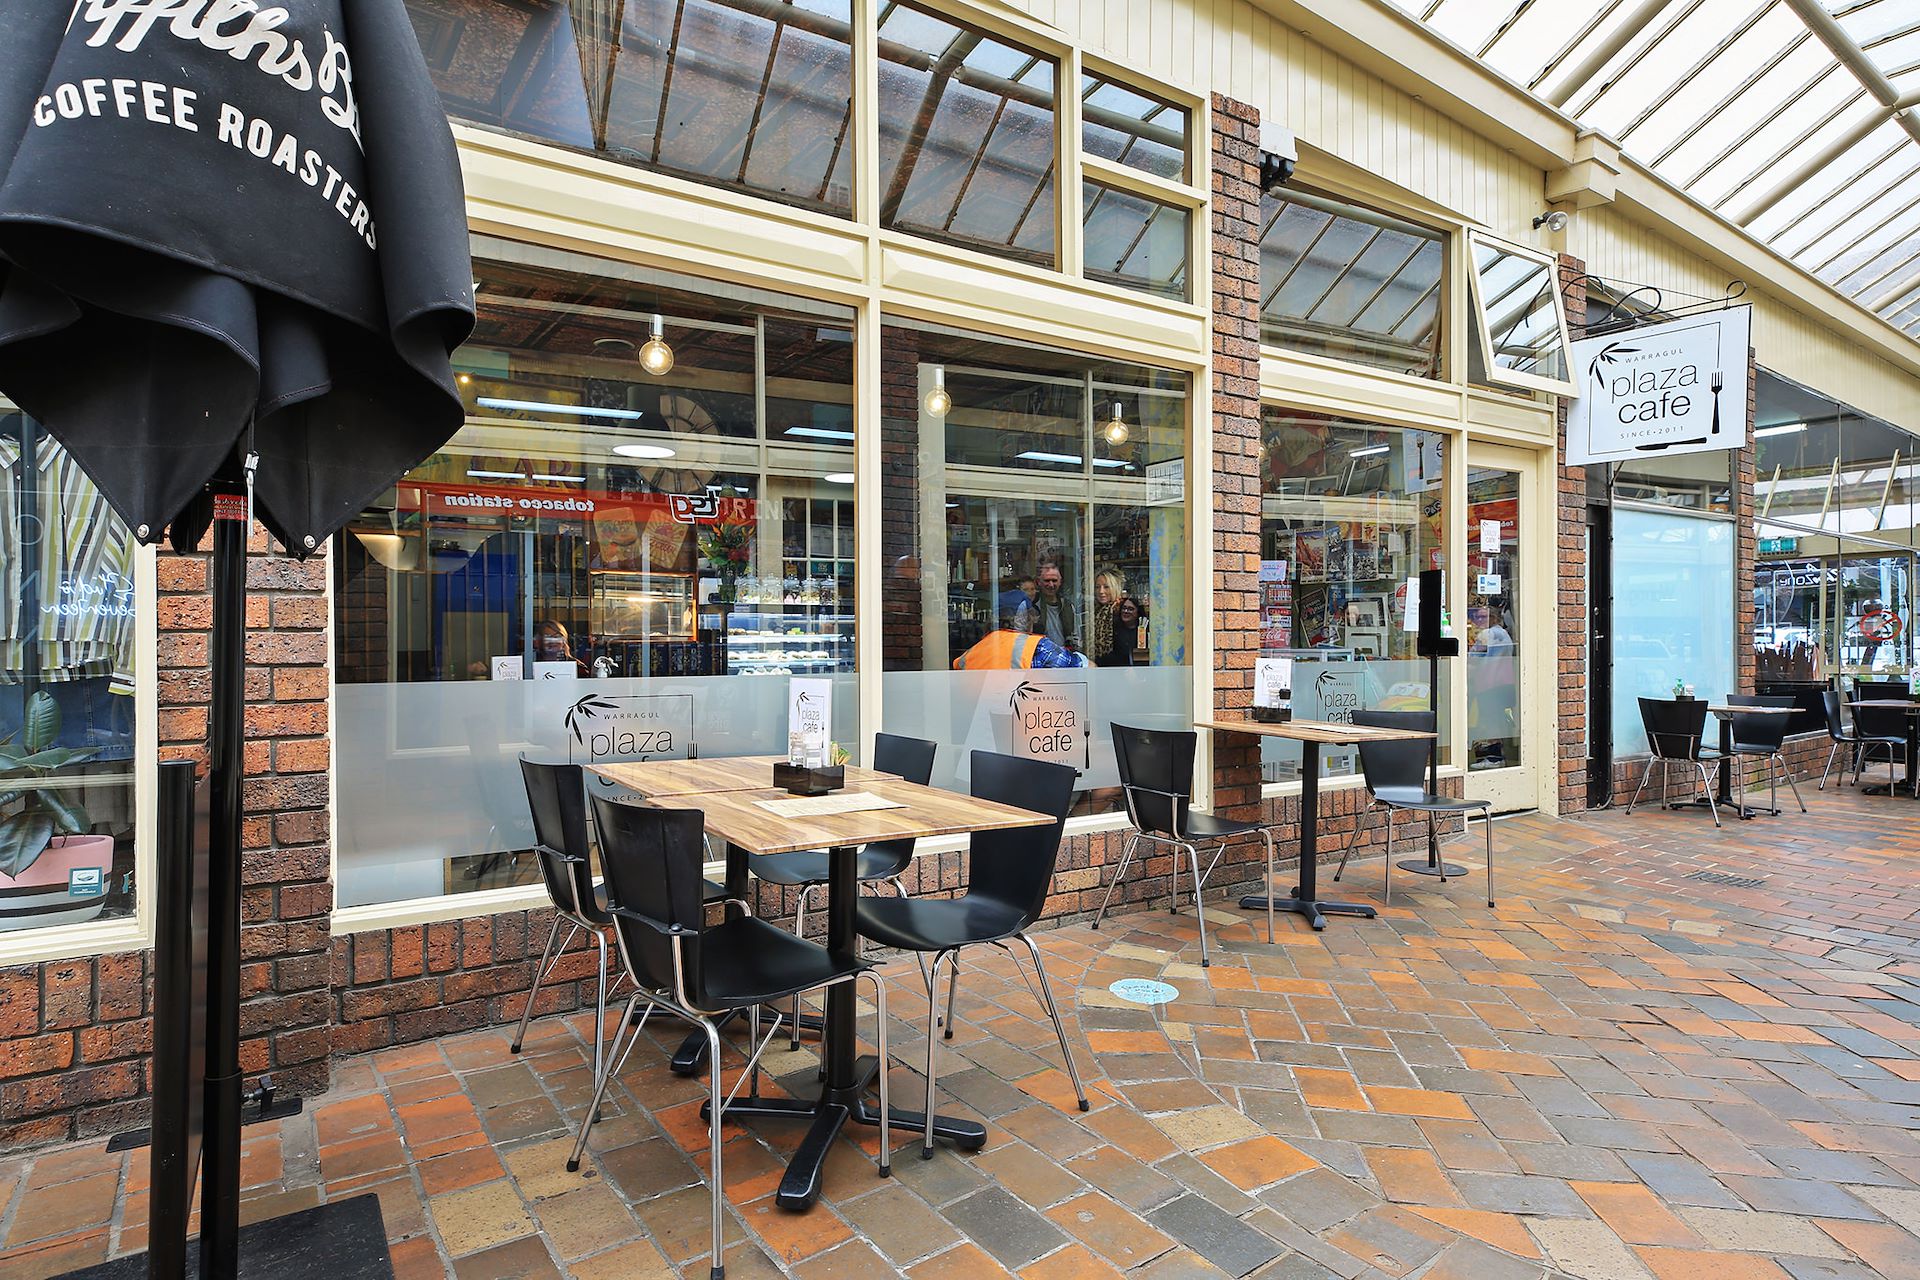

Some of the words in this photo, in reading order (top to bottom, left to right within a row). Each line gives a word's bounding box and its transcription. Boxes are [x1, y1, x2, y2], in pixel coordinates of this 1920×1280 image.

[33, 78, 199, 132] COFFEE
[218, 102, 377, 250] ROASTERS
[1625, 348, 1683, 364] WARRAGUL
[1611, 364, 1699, 404] plaza
[1618, 391, 1691, 424] cafe
[1324, 690, 1358, 712] plaza
[603, 712, 660, 720] WARRAGUL
[802, 721, 818, 733] cafe
[1024, 706, 1076, 735] plaza
[591, 726, 674, 763] plaza
[1029, 729, 1072, 754] cafe
